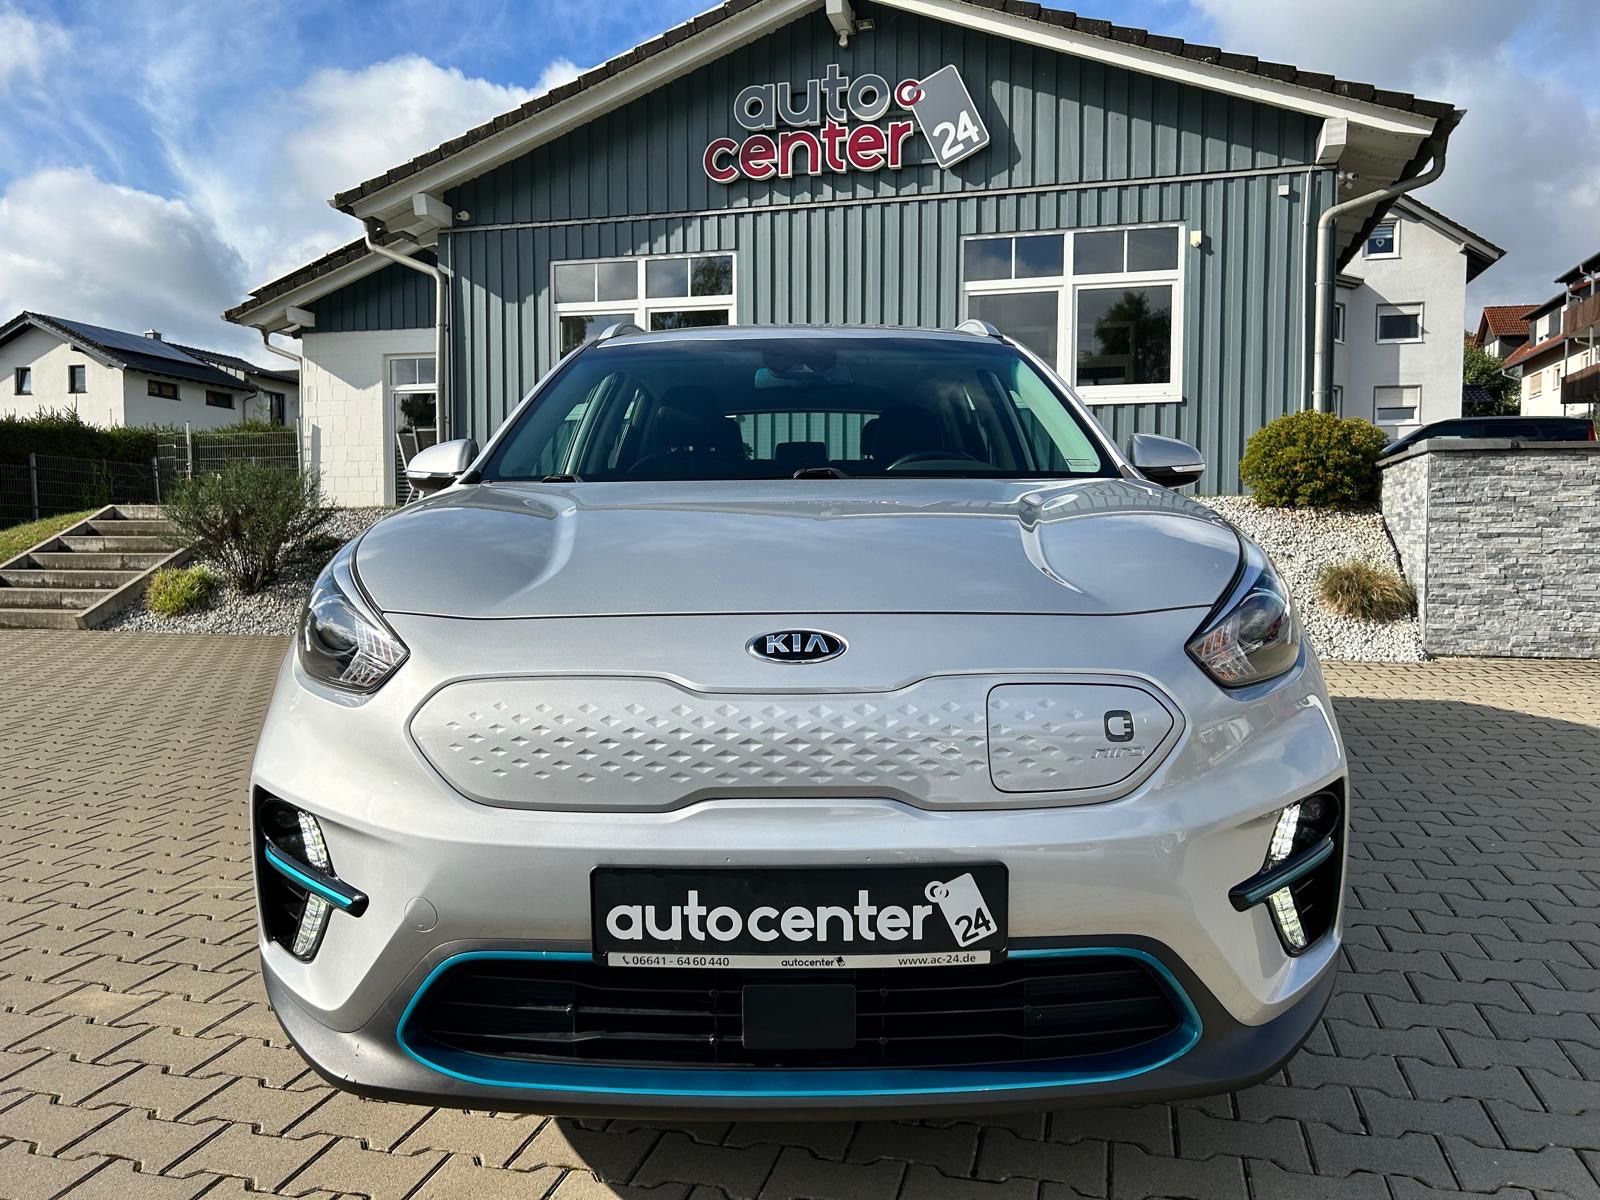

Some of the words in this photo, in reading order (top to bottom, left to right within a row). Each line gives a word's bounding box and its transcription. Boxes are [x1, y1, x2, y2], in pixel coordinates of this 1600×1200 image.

[734, 64, 890, 130] auto
[703, 115, 913, 183] center
[933, 110, 980, 160] 24
[766, 633, 829, 654] KIA
[954, 907, 991, 942] 24
[632, 955, 666, 965] 06641
[781, 957, 834, 967] autocenter
[898, 953, 976, 965] www.ac-24.de
